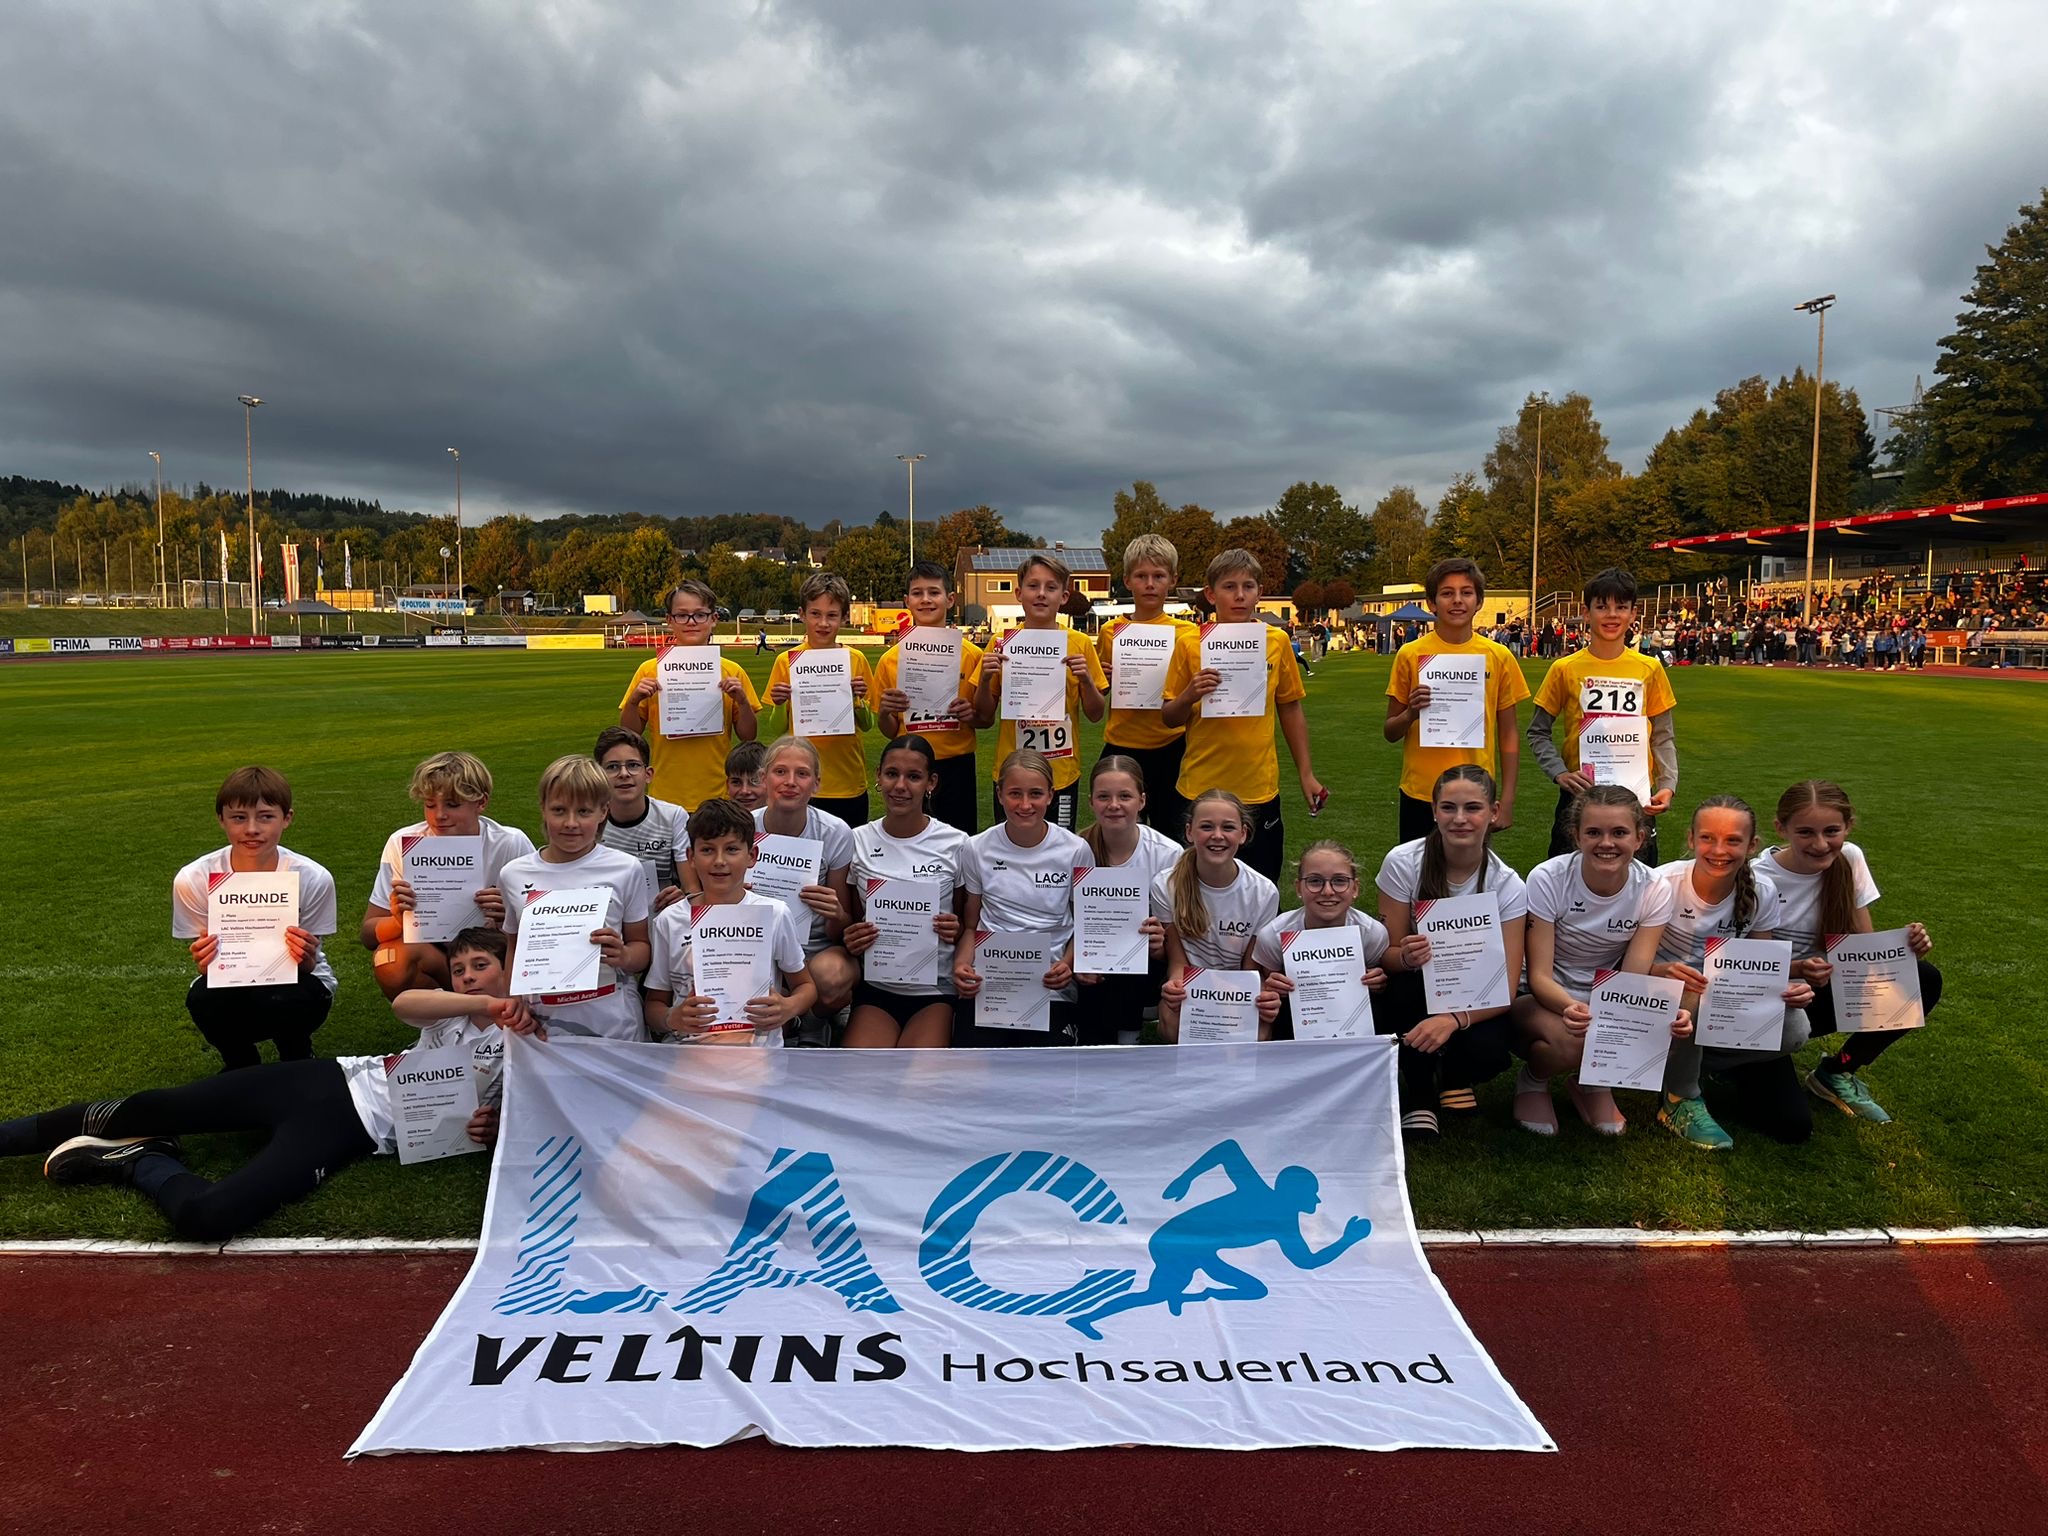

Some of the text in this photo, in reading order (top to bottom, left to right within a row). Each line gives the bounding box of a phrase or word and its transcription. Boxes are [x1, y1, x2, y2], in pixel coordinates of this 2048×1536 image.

[53, 639, 91, 650] FRIMA
[109, 639, 142, 649] FRIMA
[905, 642, 954, 653] URKUNDE
[1119, 639, 1168, 648] URKUNDE
[1207, 640, 1259, 650] URKUNDE
[1010, 646, 1060, 655] URKUNDE
[664, 662, 714, 672] URKUNDE
[796, 664, 844, 674] URKUNDE
[1426, 671, 1478, 680] URKUNDE
[1587, 689, 1637, 712] 218
[1023, 727, 1066, 749] 219
[1587, 734, 1640, 743] URKUNDE
[637, 841, 660, 851] LAC
[411, 856, 474, 867] URKUNDE
[912, 865, 936, 874] LAC
[1035, 873, 1060, 884] LAC
[1082, 887, 1140, 897] URKUNDE
[219, 893, 289, 904] URKUNDE
[532, 904, 599, 915] URKUNDE
[874, 899, 931, 912] URKUNDE
[1219, 920, 1245, 932] LAC
[1427, 914, 1491, 932] URKUNDE
[1607, 919, 1633, 929] LAC
[700, 927, 764, 939] URKUNDE
[983, 949, 1042, 959] URKUNDE
[1292, 946, 1355, 962] URKUNDE
[1837, 947, 1906, 962] URKUNDE
[1714, 958, 1780, 972] URKUNDE
[557, 995, 580, 1003] Michel
[1191, 988, 1252, 1002] URKUNDE
[1600, 991, 1669, 1010] URKUNDE
[397, 1067, 464, 1085] URKUNDE
[491, 1136, 1137, 1316] LAC
[469, 1325, 1455, 1386] VELTINS Hochsauerland
